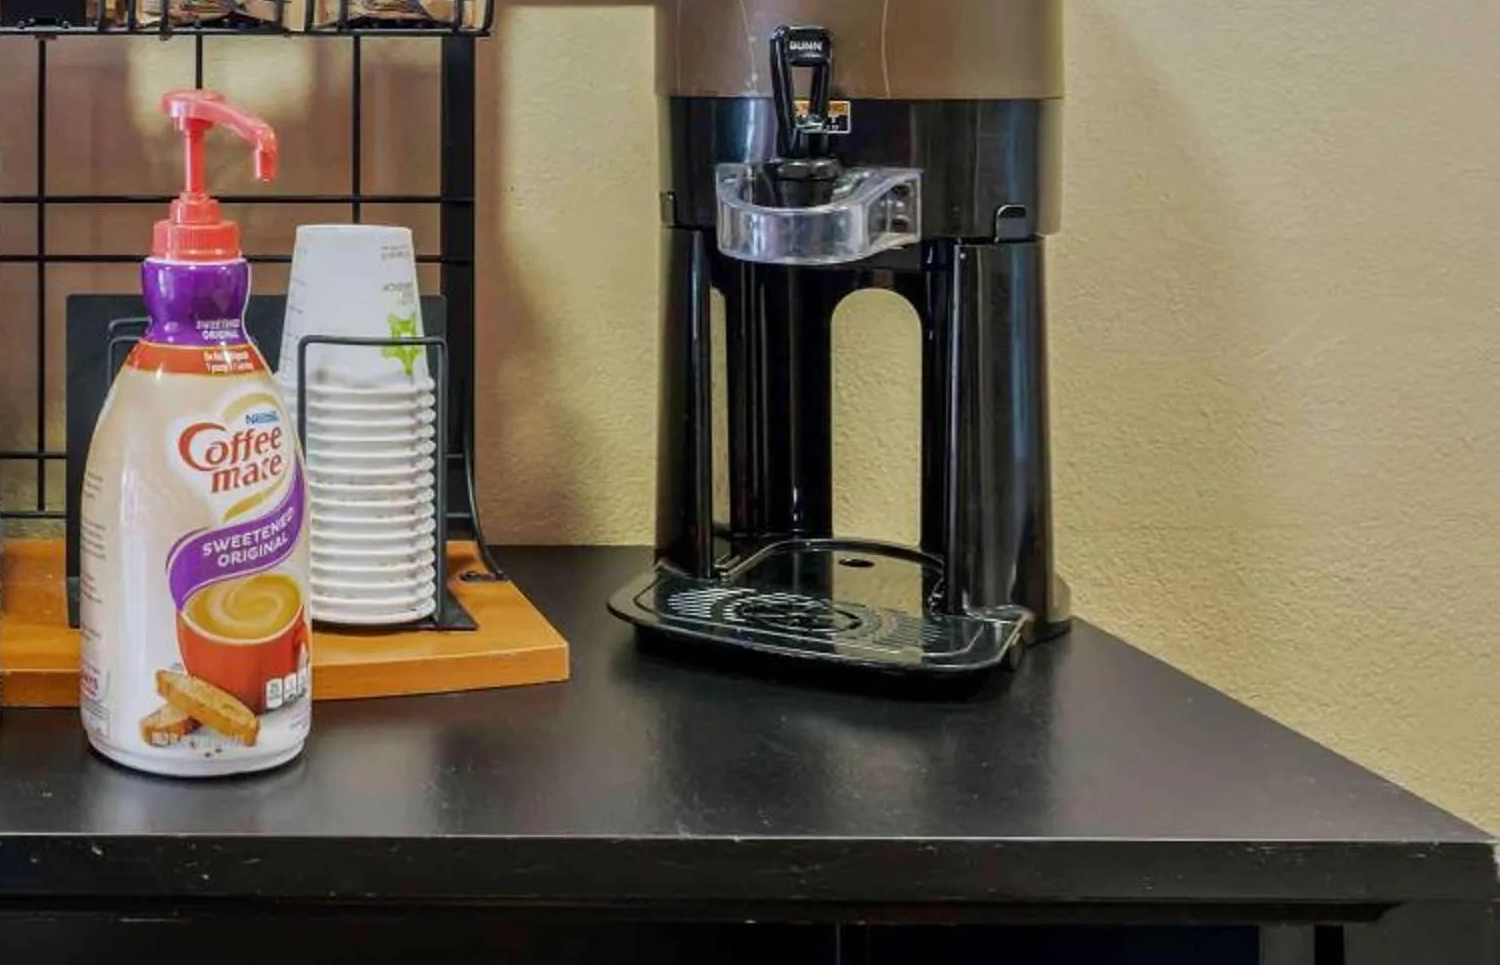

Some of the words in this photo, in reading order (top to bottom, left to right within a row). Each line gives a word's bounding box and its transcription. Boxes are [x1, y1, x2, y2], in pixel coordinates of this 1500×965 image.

[789, 40, 823, 51] BUNN
[178, 422, 282, 472] Coffee
[212, 454, 282, 494] mate
[202, 506, 294, 556] SWEETENED
[217, 533, 289, 568] ORIGINAL
